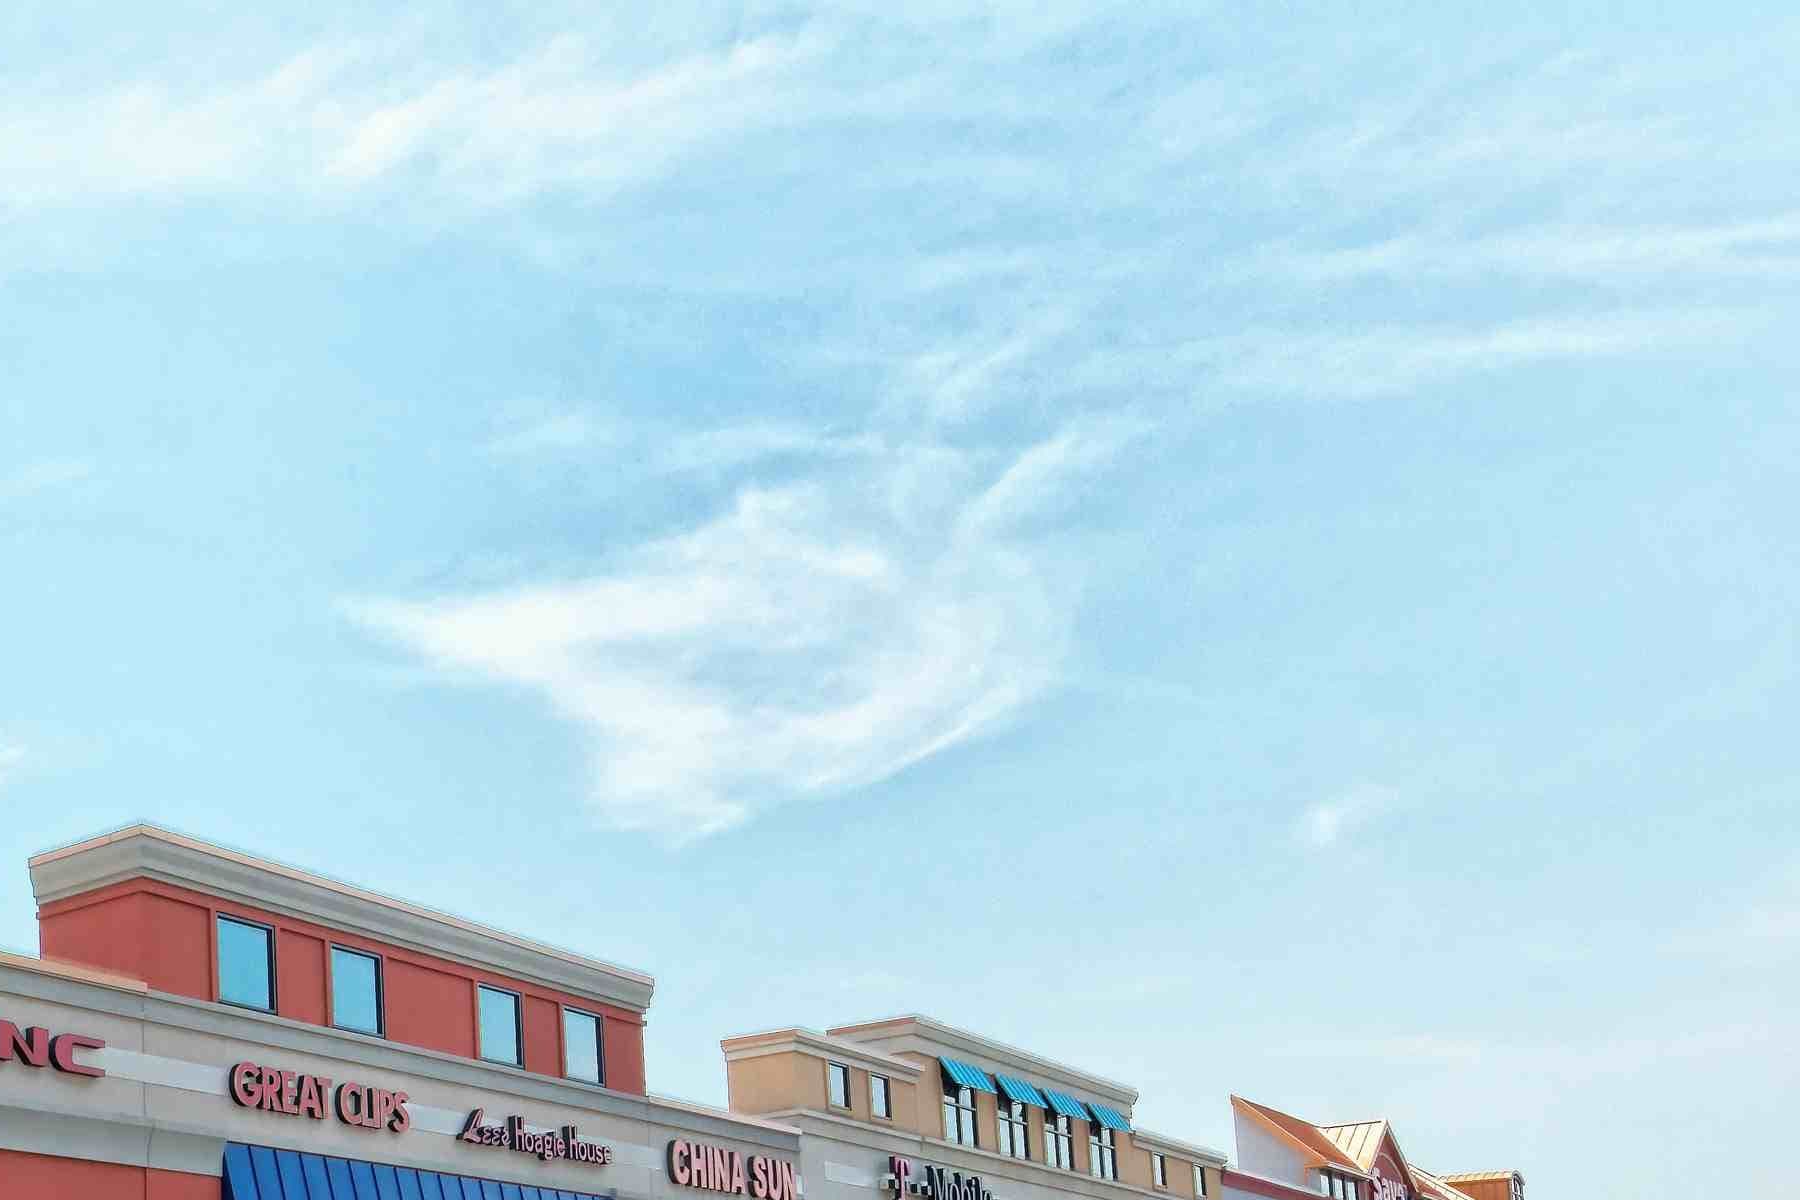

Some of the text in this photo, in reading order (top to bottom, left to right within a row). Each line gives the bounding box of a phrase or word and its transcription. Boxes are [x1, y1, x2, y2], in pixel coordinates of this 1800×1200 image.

[228, 1060, 411, 1133] GREAT CLIPS
[508, 1114, 566, 1160] Hoagie
[667, 1138, 745, 1194] CHINA
